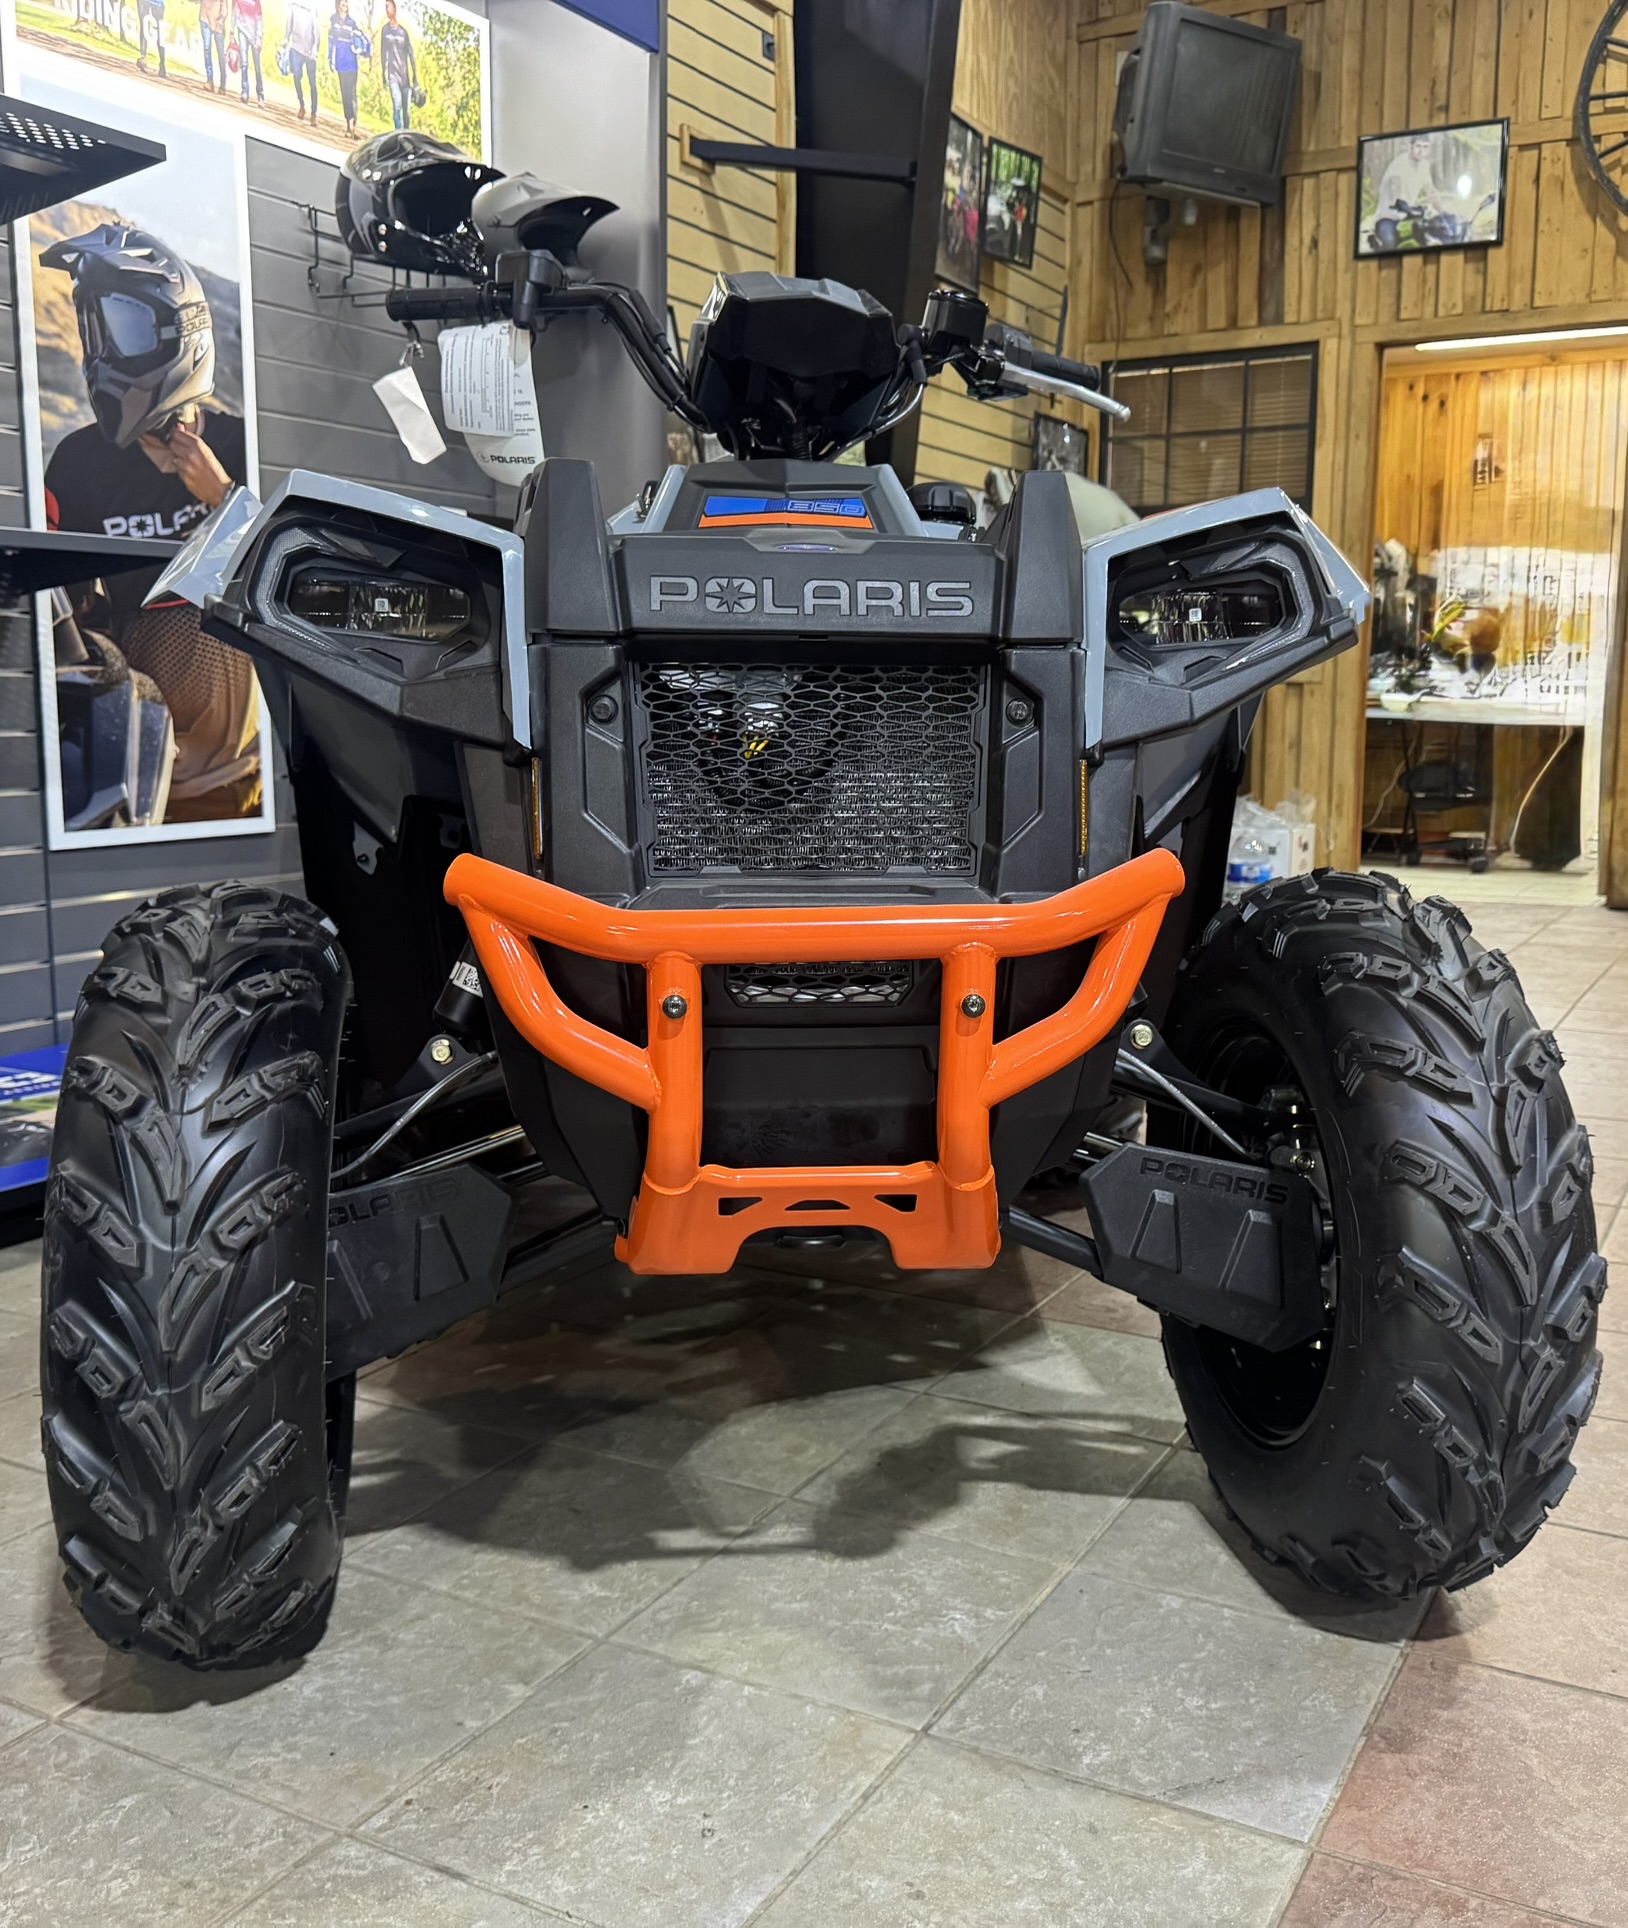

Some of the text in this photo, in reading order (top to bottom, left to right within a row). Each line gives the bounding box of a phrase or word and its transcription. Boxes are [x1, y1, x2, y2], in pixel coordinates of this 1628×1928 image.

[489, 454, 536, 465] POLARIS
[102, 502, 213, 538] POLA
[787, 500, 866, 516] 850
[649, 575, 975, 617] POLARIS
[1139, 1156, 1290, 1206] POLARIS
[327, 1177, 460, 1229] OLARIS
